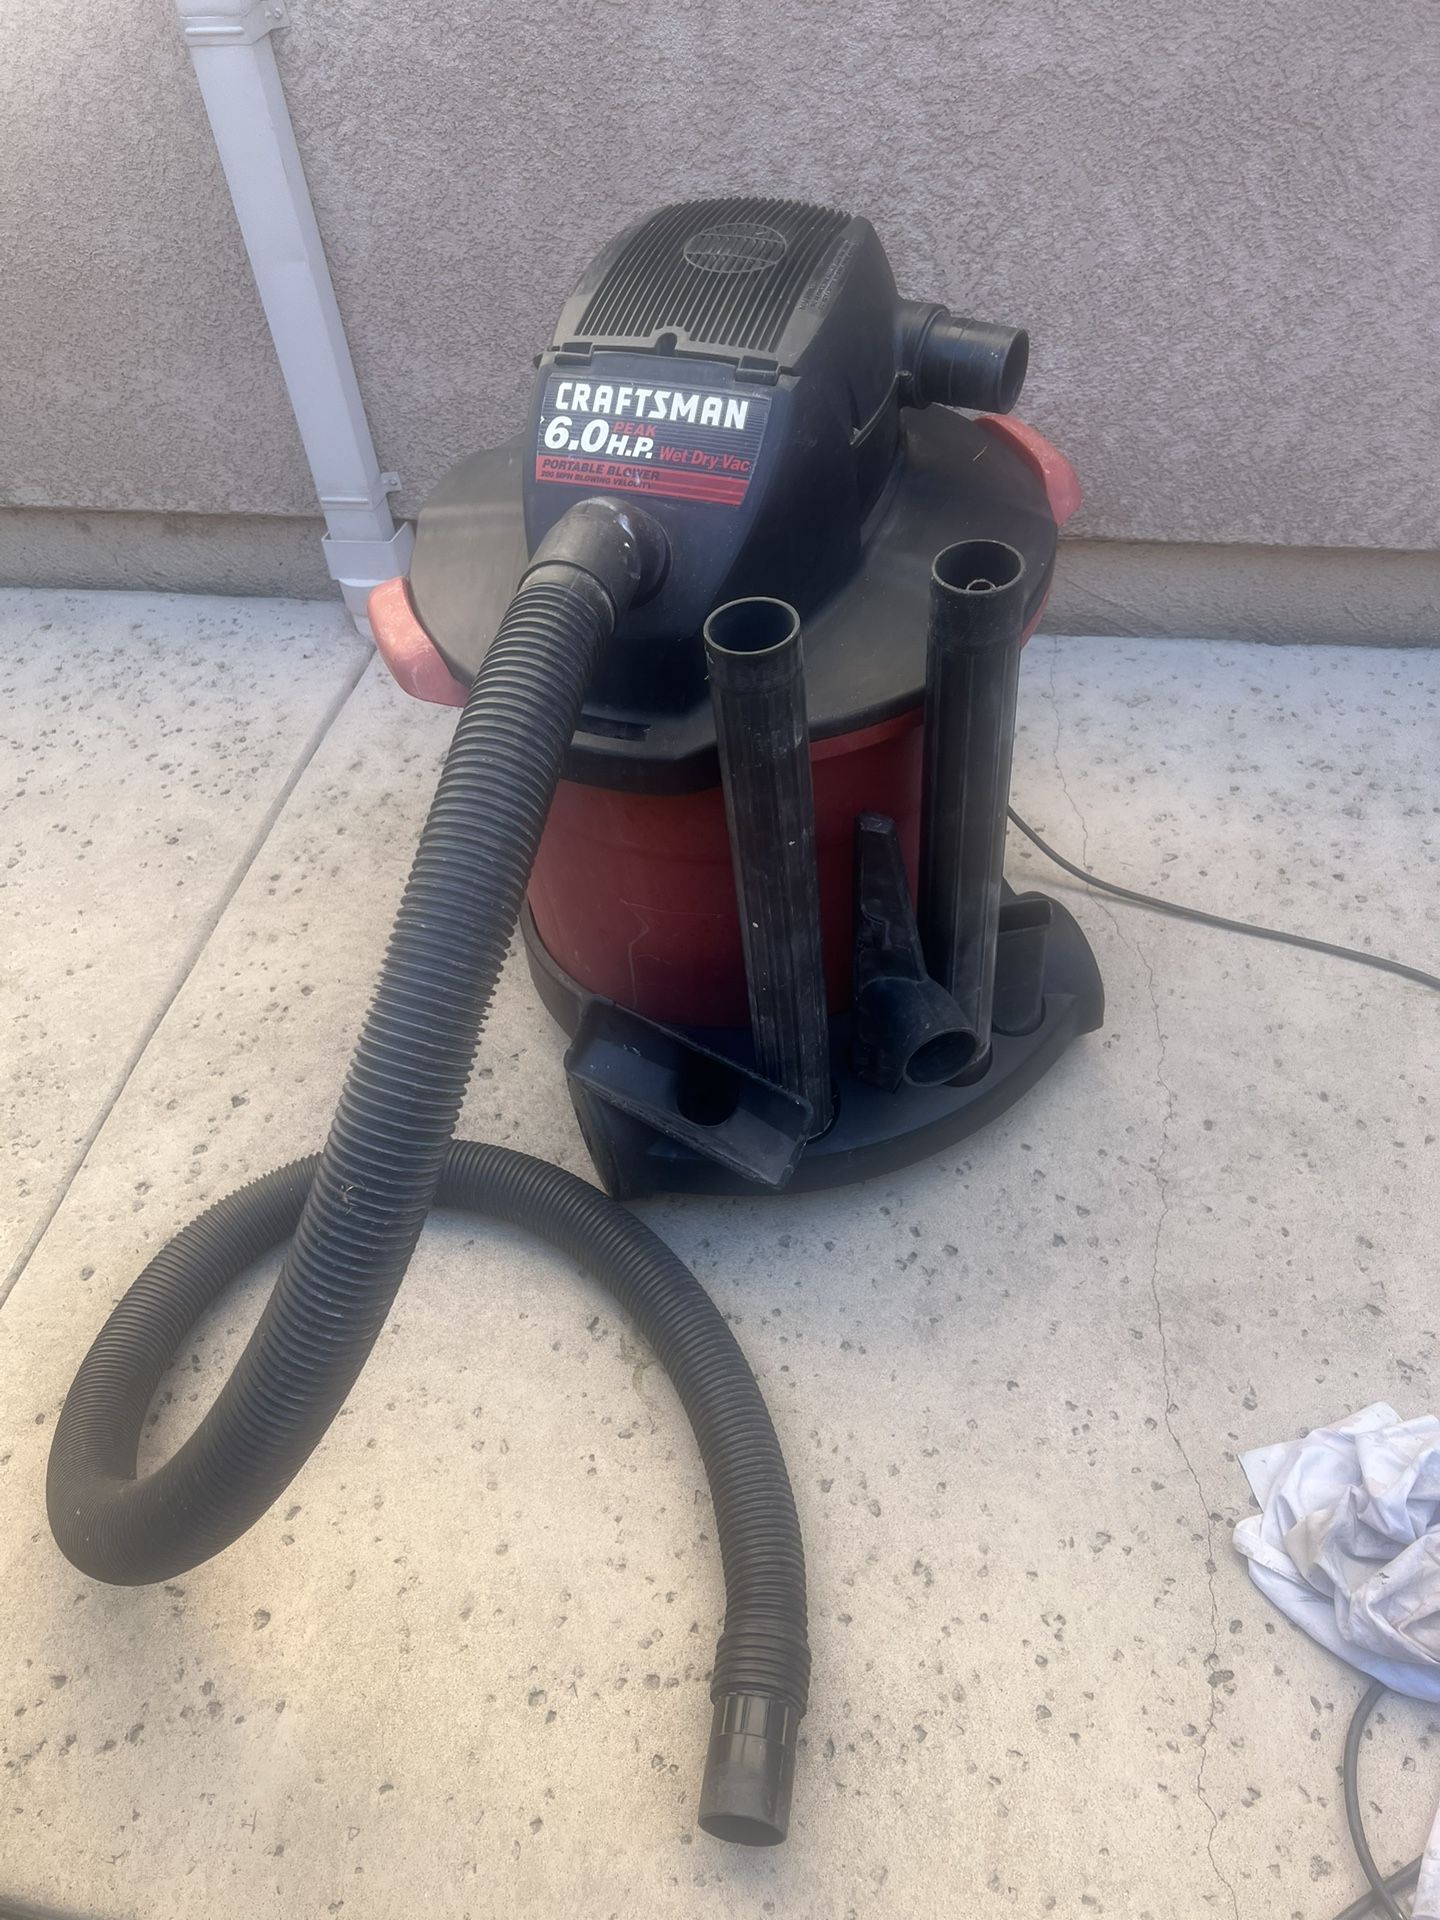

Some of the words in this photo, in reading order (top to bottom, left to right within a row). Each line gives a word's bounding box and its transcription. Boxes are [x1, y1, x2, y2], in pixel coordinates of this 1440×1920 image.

[555, 382, 749, 429] CRAFTSMAN
[612, 421, 657, 437] PEAK
[544, 416, 610, 453] 6.0
[606, 433, 654, 459] H.P.
[660, 446, 689, 464] Wet
[690, 449, 720, 470] Dry
[722, 453, 751, 472] Vac
[542, 459, 605, 474] PORTABLE
[606, 465, 660, 481] BLOWER
[574, 473, 612, 485] BLOWING
[613, 478, 654, 489] VELOCITY
